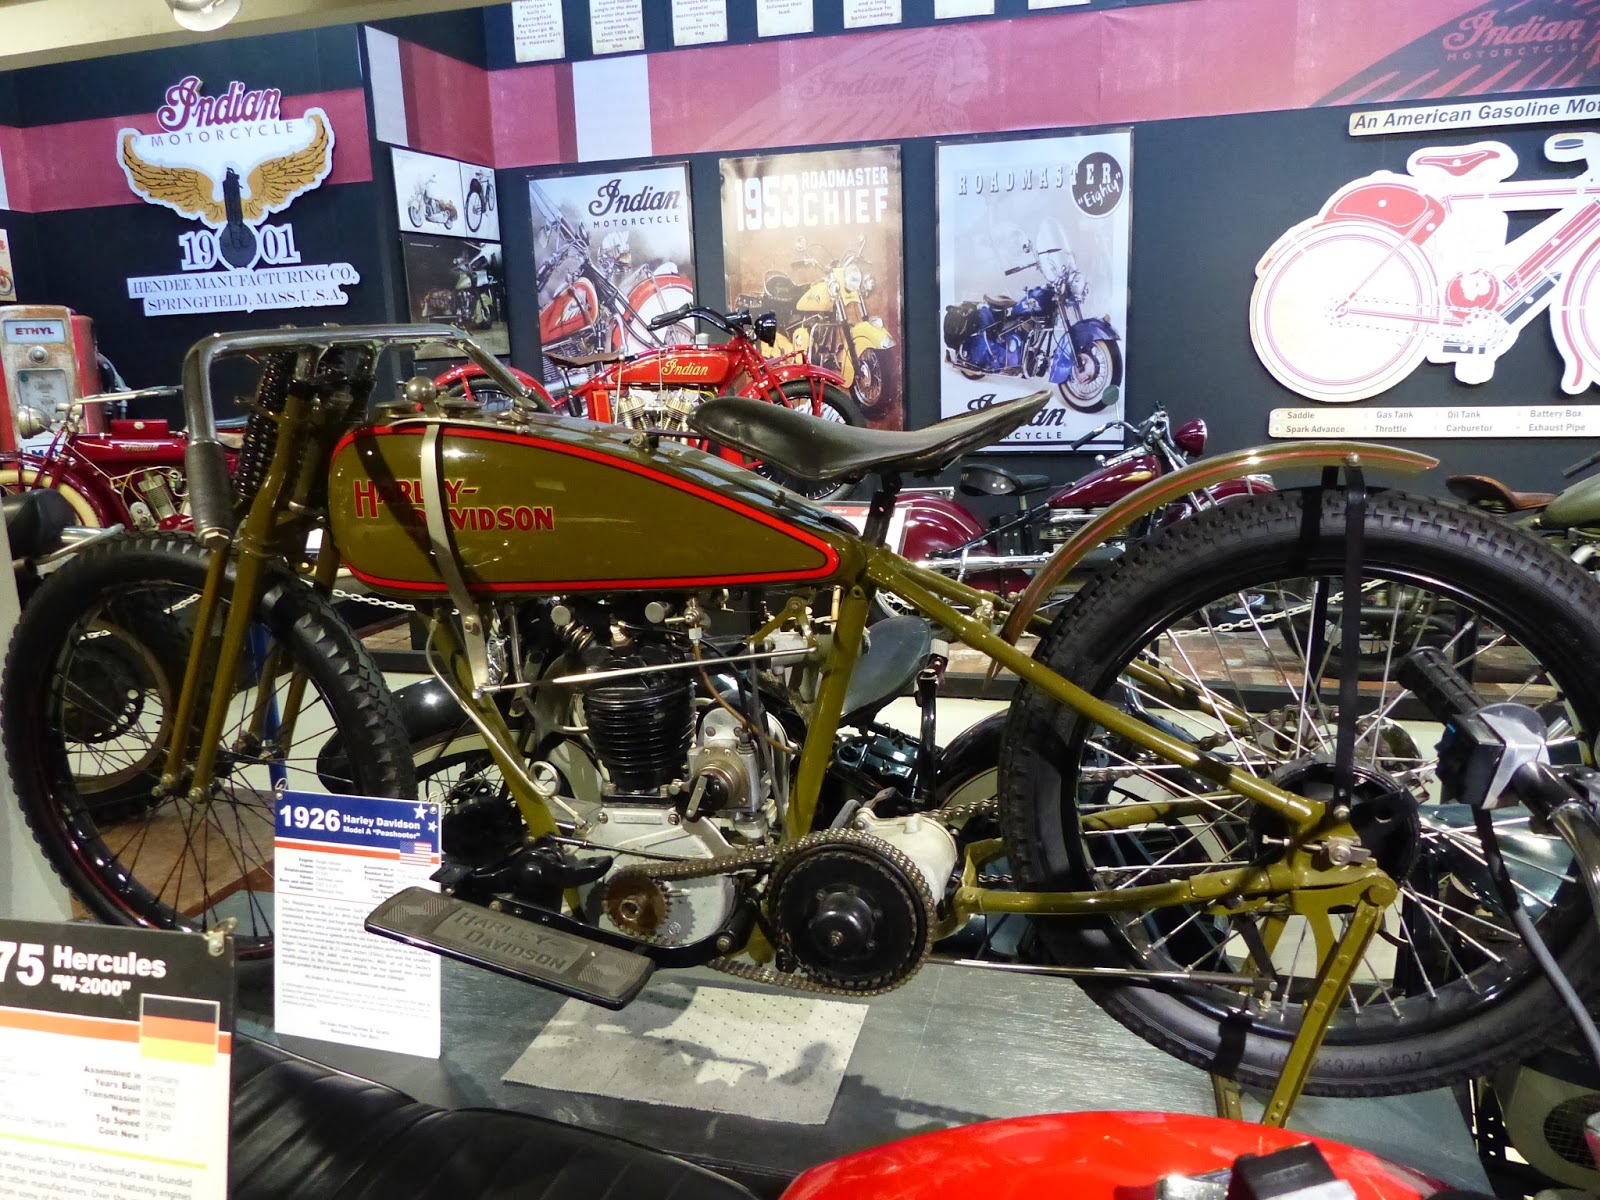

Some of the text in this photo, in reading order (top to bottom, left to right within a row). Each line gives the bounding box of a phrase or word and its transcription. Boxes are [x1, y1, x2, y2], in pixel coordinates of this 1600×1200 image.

[1443, 10, 1585, 50] Indian
[1447, 43, 1579, 61] MOTORCYCLE
[157, 76, 281, 132] Indian
[1353, 114, 1378, 130] An
[1383, 107, 1471, 128] American
[1478, 101, 1560, 120] Gasoline
[151, 121, 294, 148] MOTORCYCLE
[801, 166, 889, 190] ROADMASTER
[959, 162, 1112, 195] ROADMASTER
[588, 179, 681, 217] Indian
[734, 174, 801, 232] 1953
[803, 187, 889, 227] CHIEF
[593, 215, 680, 229] MOTORCYCLE
[133, 266, 356, 294] HENDEE MANUFACTURING CO.
[147, 293, 252, 311] SPRINGFIELD,
[661, 358, 709, 376] Indian
[1287, 411, 1315, 419] Saddle
[1376, 411, 1392, 419] Gas
[1395, 410, 1414, 419] Tank
[1447, 410, 1459, 419] Oil
[1461, 410, 1481, 419] Tank
[1530, 409, 1563, 419] Battery
[1565, 409, 1582, 418] Box
[1286, 425, 1310, 434] Spark
[1311, 425, 1346, 433] Advance
[1375, 425, 1407, 433] Throttle
[1446, 424, 1493, 432] Carburetor
[1528, 423, 1564, 432] Exhaust
[1566, 423, 1586, 433] Pipe
[279, 804, 421, 833] 1926 Harley Davidson
[342, 825, 421, 840] Model A "Peashooter"
[464, 930, 567, 971] DAVIDSON
[53, 944, 167, 979] Hercules
[51, 974, 132, 997] "W-2000"
[84, 1065, 131, 1078] Assembled
[95, 1078, 118, 1089] Years
[121, 1081, 141, 1092] Built
[84, 1088, 141, 1104] Transmission
[96, 1113, 111, 1124] Top
[114, 1116, 140, 1128] Speed
[111, 1105, 140, 1117] Weight
[98, 1126, 140, 1140] Cost New
[157, 1173, 193, 1188] founded
